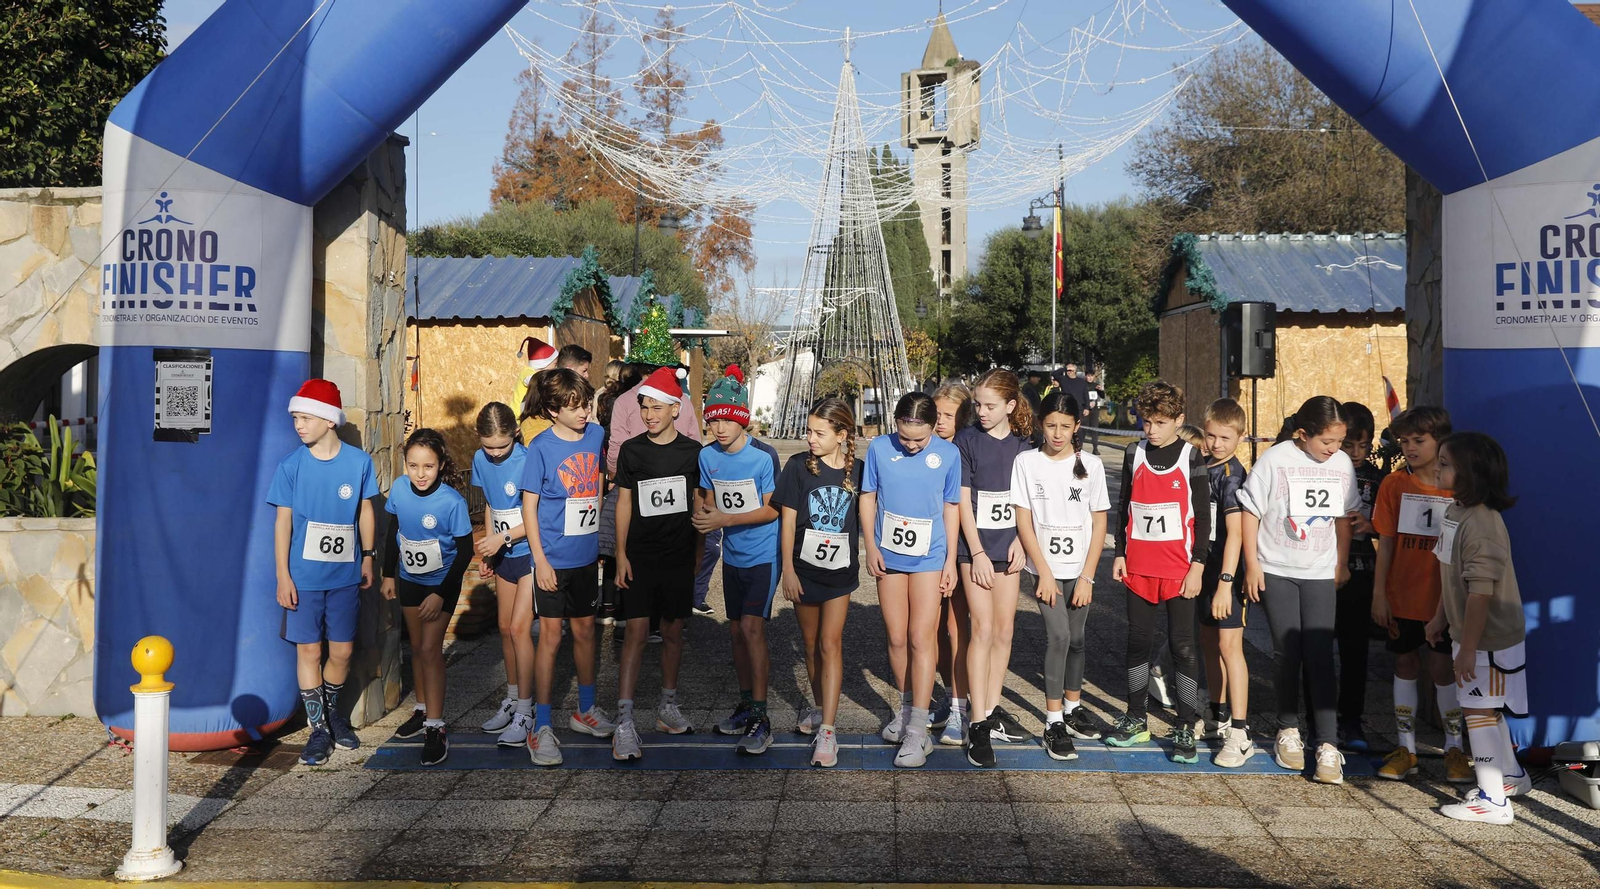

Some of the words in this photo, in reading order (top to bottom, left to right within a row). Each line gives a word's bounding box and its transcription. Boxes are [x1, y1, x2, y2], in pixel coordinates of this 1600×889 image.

[123, 228, 218, 263] CRONO
[103, 262, 257, 312] FINISHER
[139, 314, 144, 322] Y
[146, 313, 206, 323] ORGANIZACIÓN
[208, 315, 219, 323] DE
[221, 316, 259, 326] EVENTOS
[1496, 315, 1567, 324] CRONOMETRAJE
[1570, 315, 1577, 323] Y
[1579, 314, 1600, 322] ORG
[651, 488, 675, 508] 64
[722, 491, 745, 509] 63
[1305, 489, 1330, 508] 52
[579, 508, 597, 527] 72
[991, 503, 1012, 522] 55
[1423, 508, 1432, 527] 1
[1143, 515, 1166, 533] 71
[319, 536, 345, 554] 68
[892, 527, 917, 547] 59
[1049, 537, 1074, 555] 53
[1402, 537, 1416, 549] FLY
[405, 550, 428, 567] 39
[815, 543, 840, 562] 57
